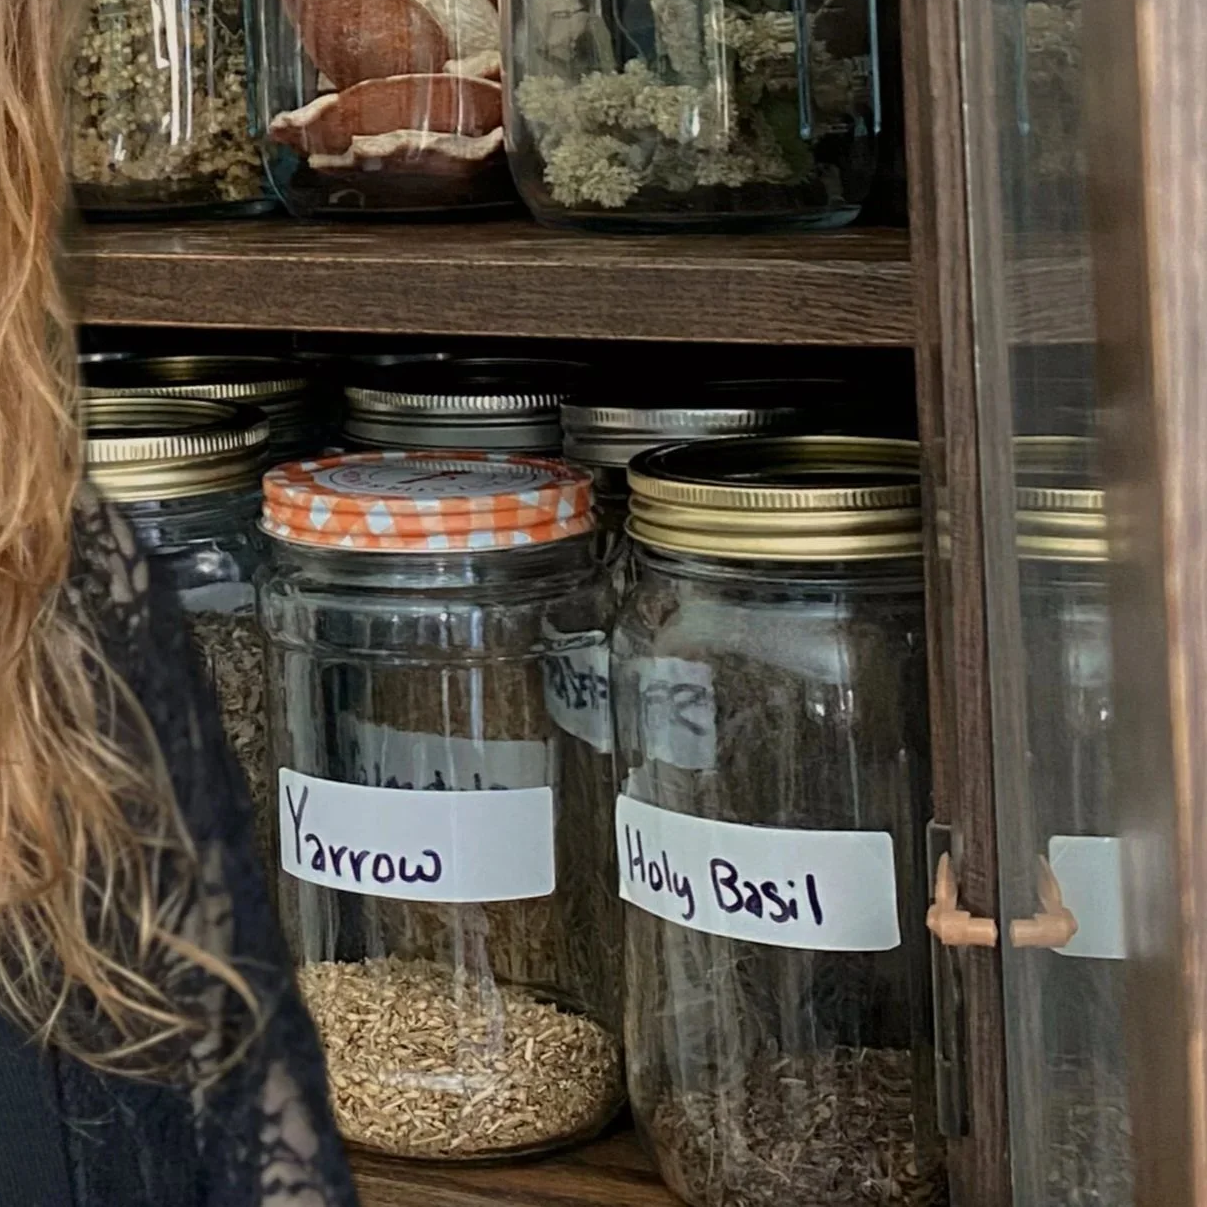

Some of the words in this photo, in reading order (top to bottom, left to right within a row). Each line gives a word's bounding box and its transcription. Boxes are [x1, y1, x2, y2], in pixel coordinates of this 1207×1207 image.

[285, 784, 443, 884] Yarrow
[625, 824, 696, 921] Holy
[710, 857, 824, 926] Basil
